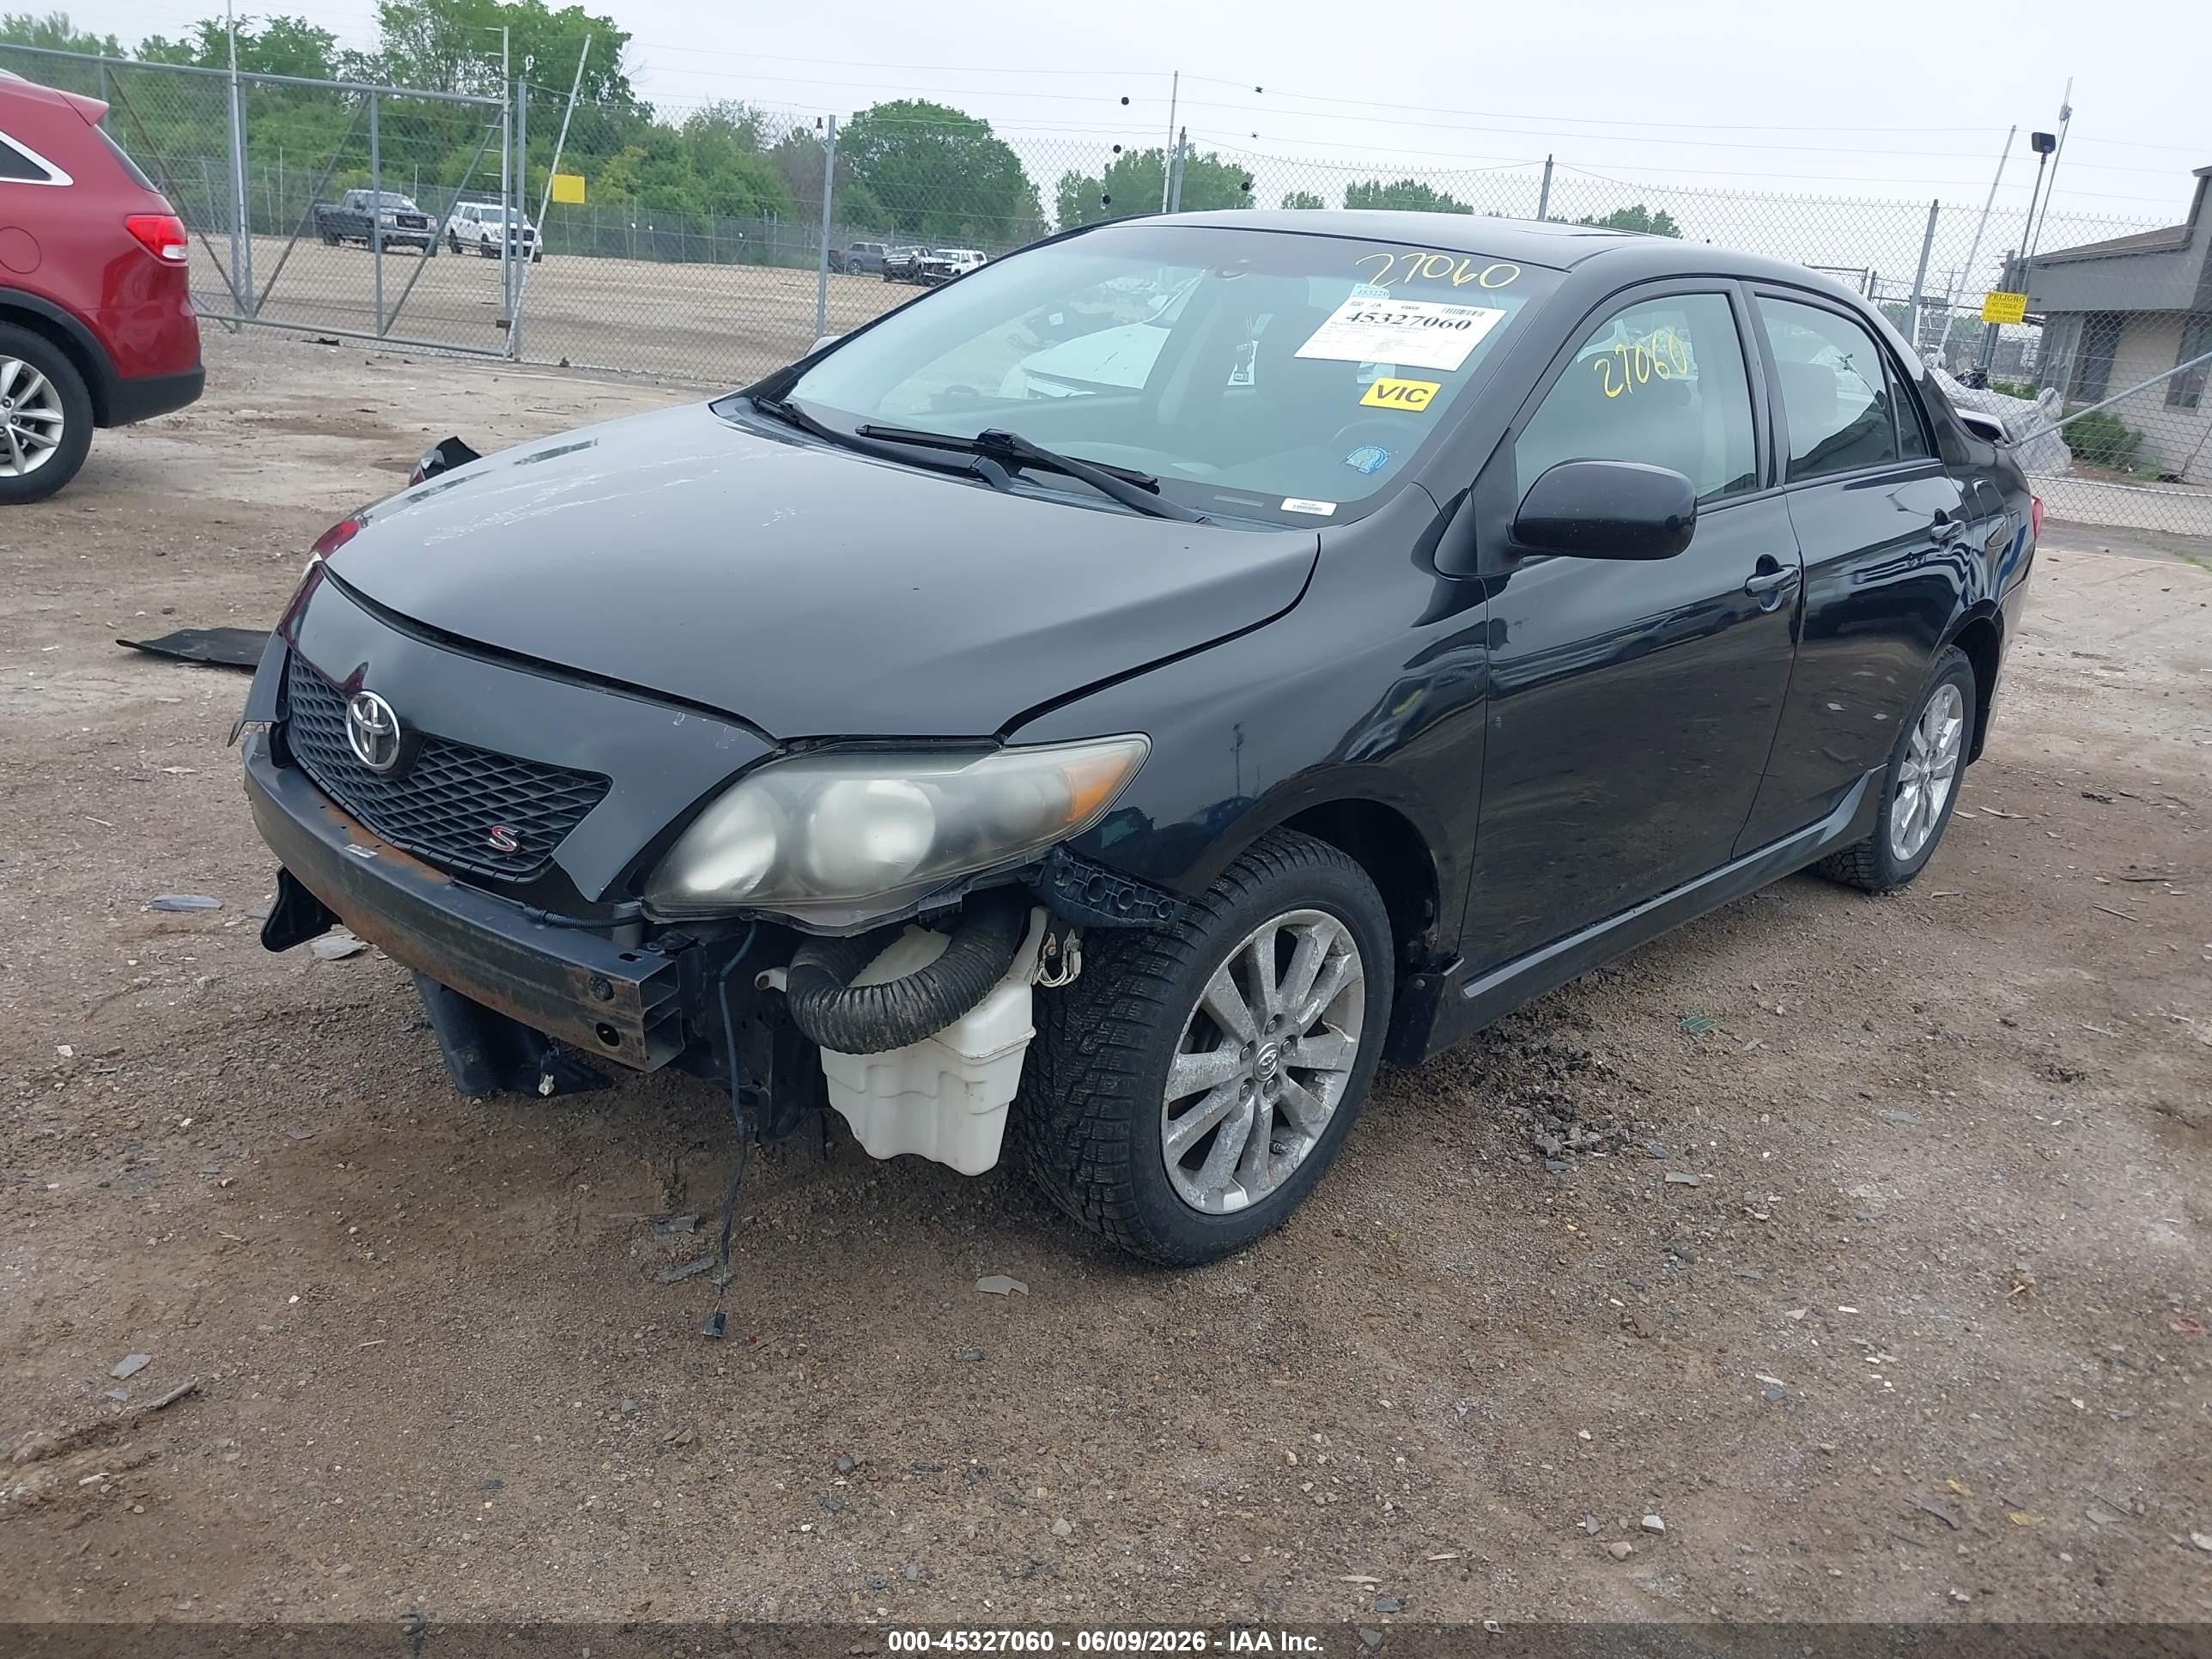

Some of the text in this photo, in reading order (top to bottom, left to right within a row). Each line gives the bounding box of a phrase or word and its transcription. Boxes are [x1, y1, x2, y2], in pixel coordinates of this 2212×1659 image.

[1355, 252, 1521, 289] 27060
[1988, 293, 2026, 303] PELIGRO
[1346, 311, 1472, 331] 45327060
[1594, 329, 1688, 398] 27060
[1377, 385, 1429, 403] VIC
[489, 825, 519, 852] S
